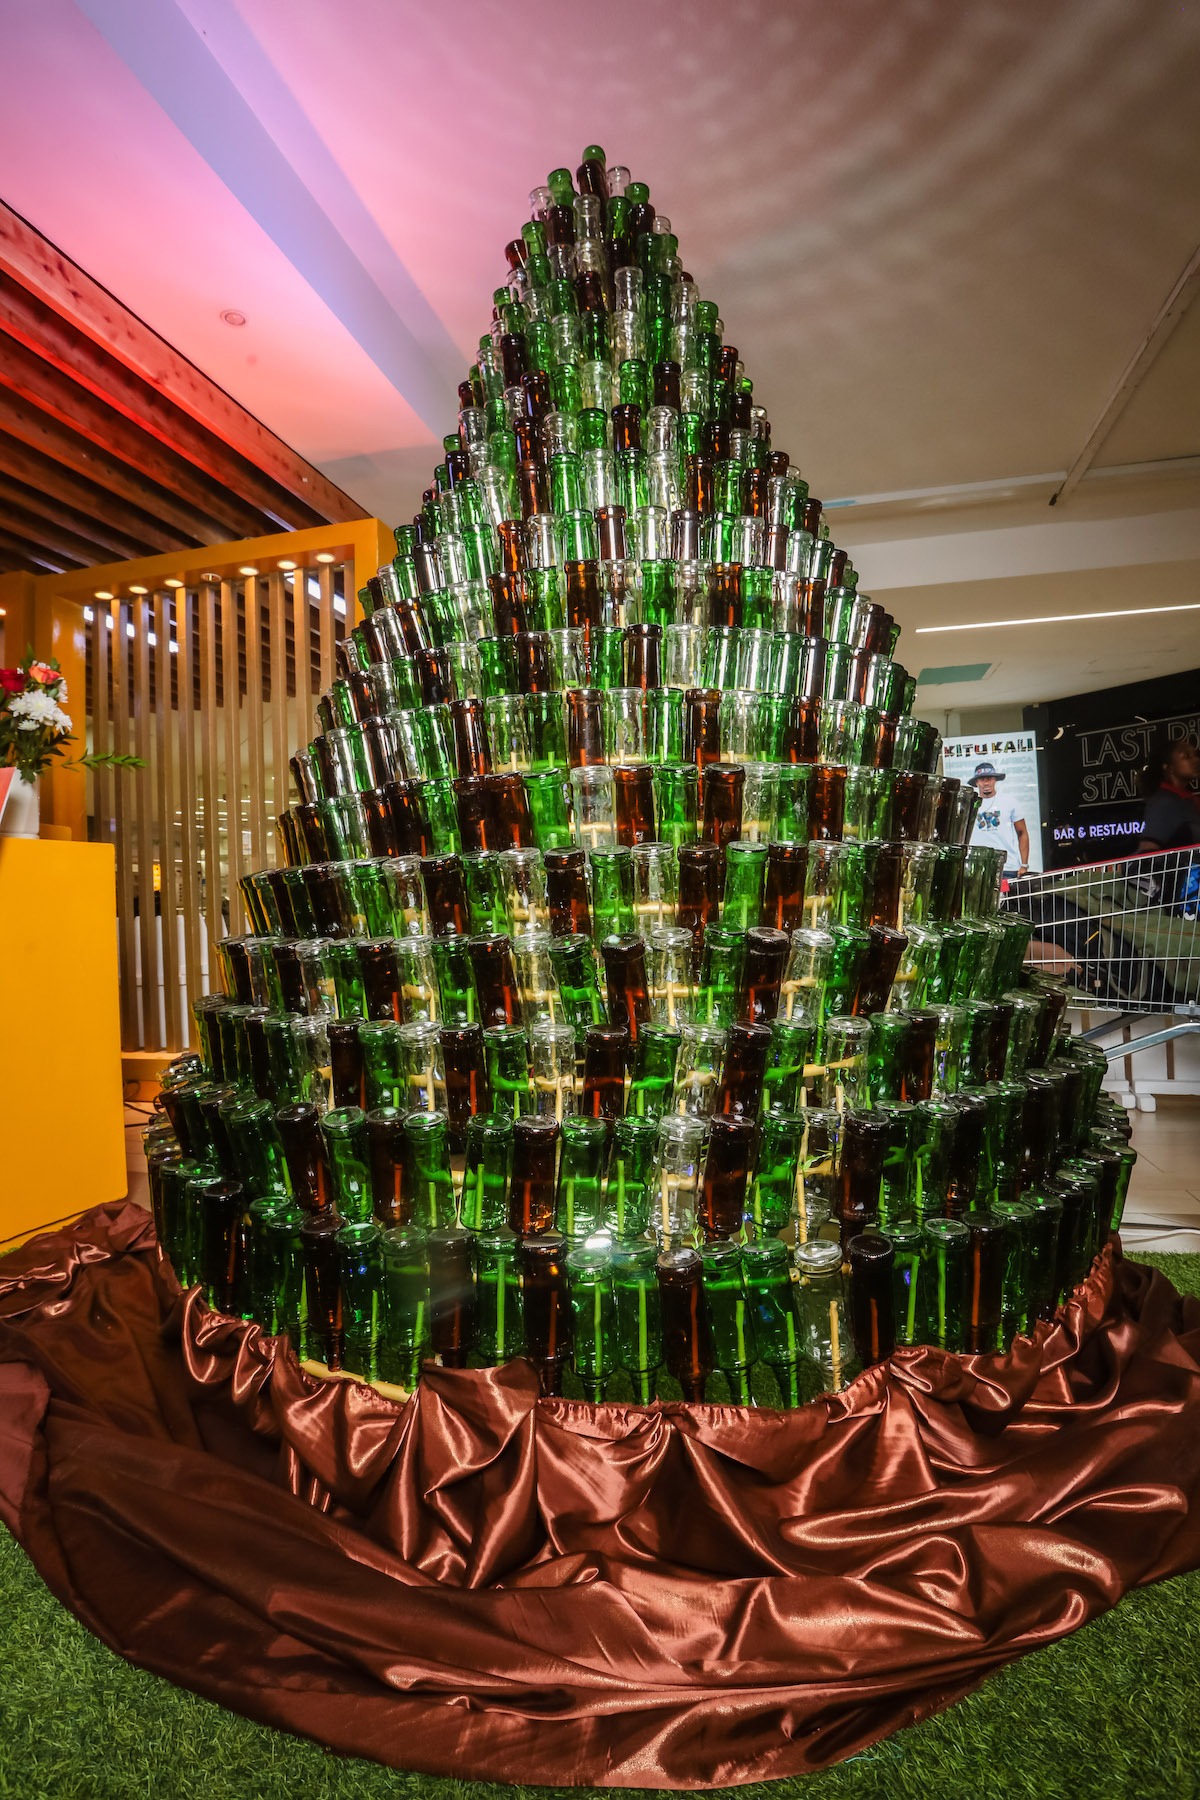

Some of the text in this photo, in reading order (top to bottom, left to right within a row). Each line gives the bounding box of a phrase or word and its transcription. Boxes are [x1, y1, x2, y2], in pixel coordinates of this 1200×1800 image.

[944, 738, 1034, 758] KITU KALI
[1081, 725, 1156, 767] LAST
[1053, 827, 1075, 840] BAR
[1078, 826, 1086, 838] &
